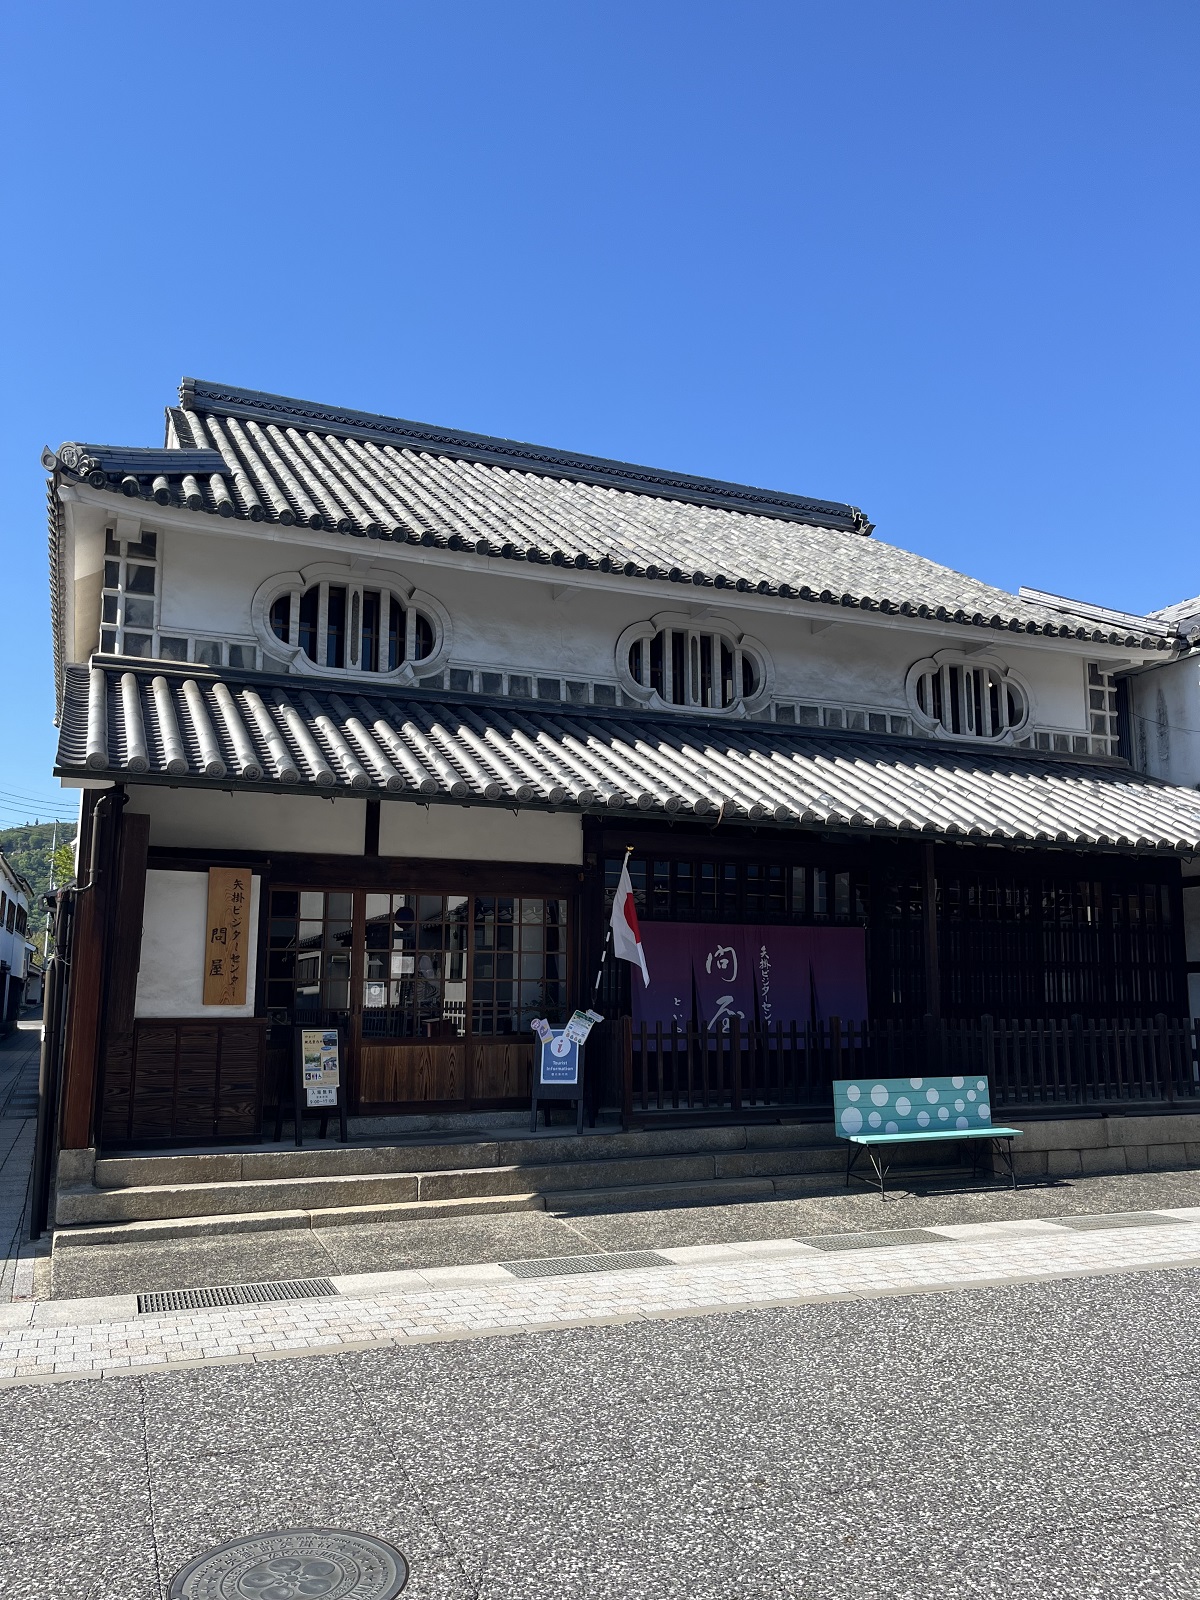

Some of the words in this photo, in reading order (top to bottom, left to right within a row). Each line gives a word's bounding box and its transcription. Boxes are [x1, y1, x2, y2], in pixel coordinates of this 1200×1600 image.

[209, 927, 228, 977] 問屋
[229, 878, 245, 997] 矢掛ビジターセンター
